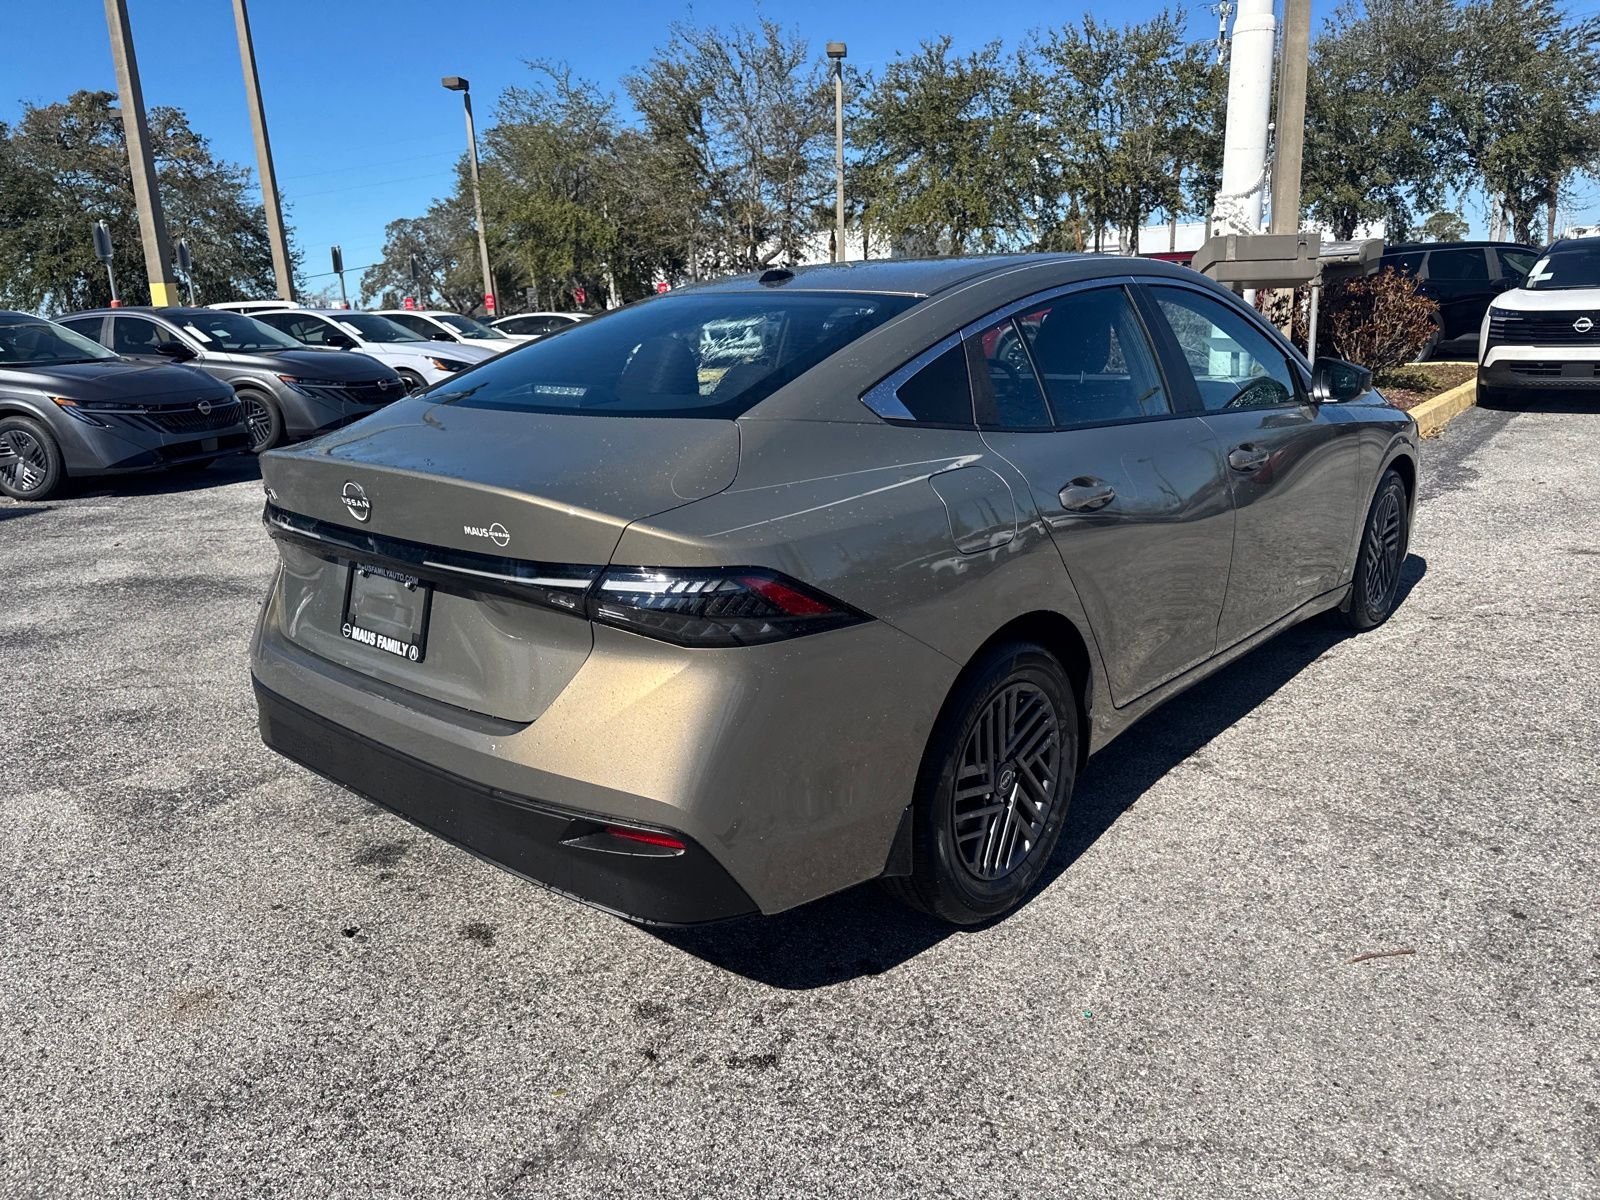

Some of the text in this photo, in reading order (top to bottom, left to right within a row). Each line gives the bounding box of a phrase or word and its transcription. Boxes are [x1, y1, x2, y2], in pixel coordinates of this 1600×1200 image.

[464, 526, 488, 537] MAUS
[357, 562, 419, 584] USFAMILYAUTO.COM
[352, 626, 409, 657] MAUS FAMILY
